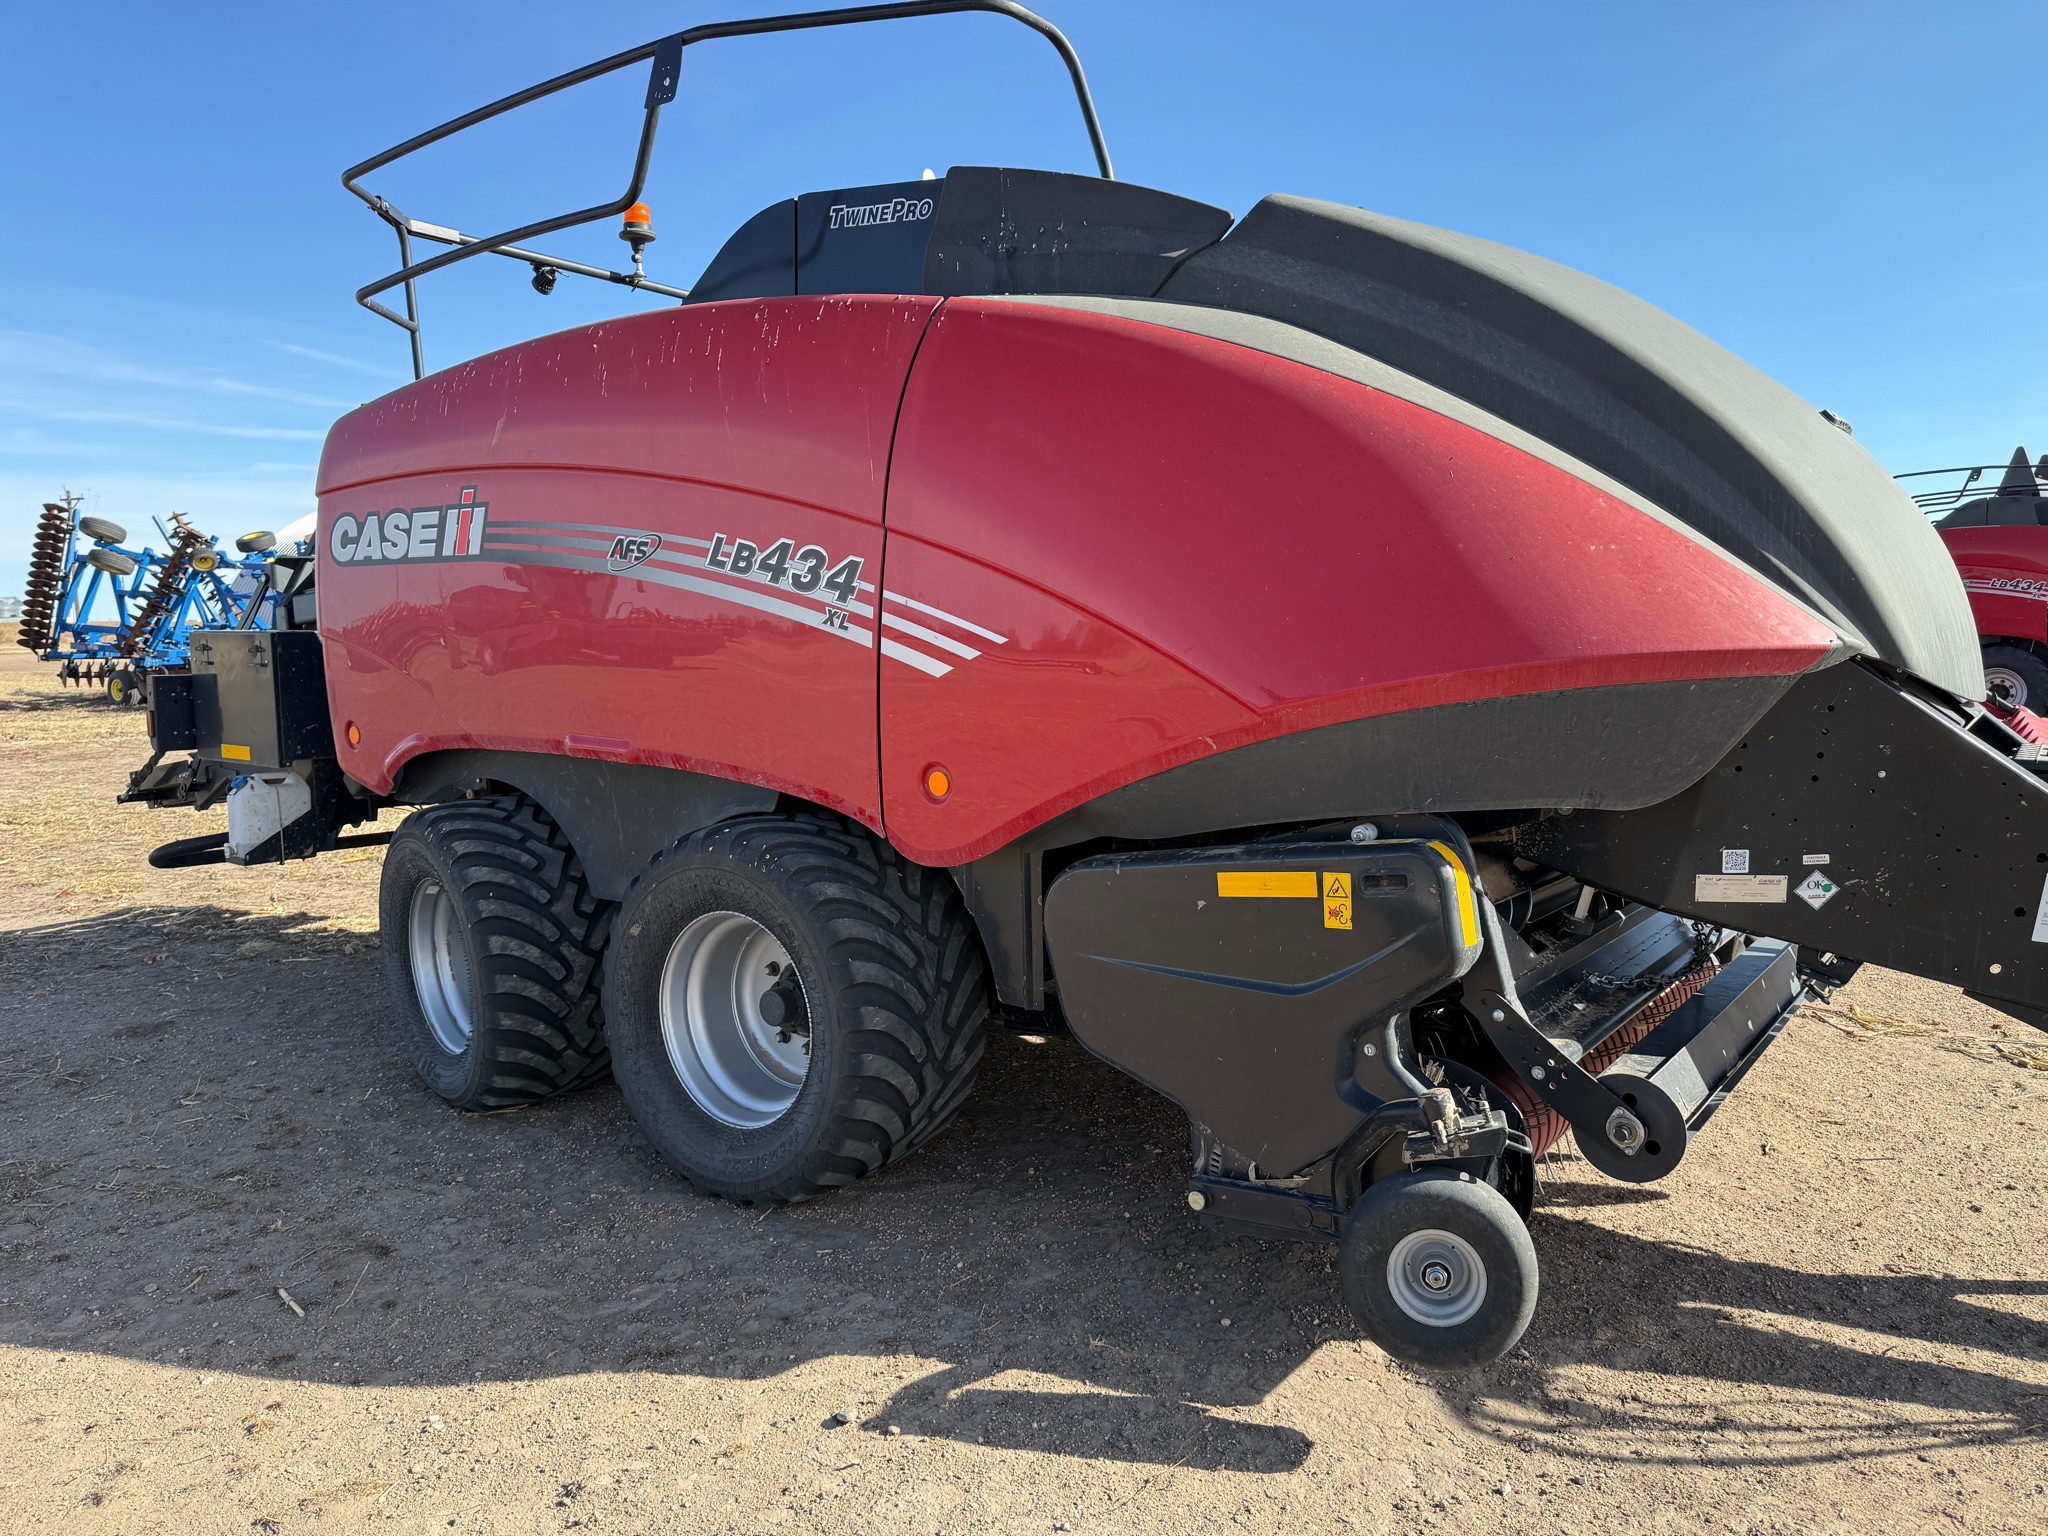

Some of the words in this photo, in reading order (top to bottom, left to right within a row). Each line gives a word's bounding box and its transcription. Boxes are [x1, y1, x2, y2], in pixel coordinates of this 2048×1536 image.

[331, 511, 440, 562] CASE
[607, 535, 652, 563] AFS
[705, 532, 865, 606] LB434
[1989, 578, 2047, 593] LB434
[820, 606, 850, 631] XL
[1807, 880, 1825, 889] OK
